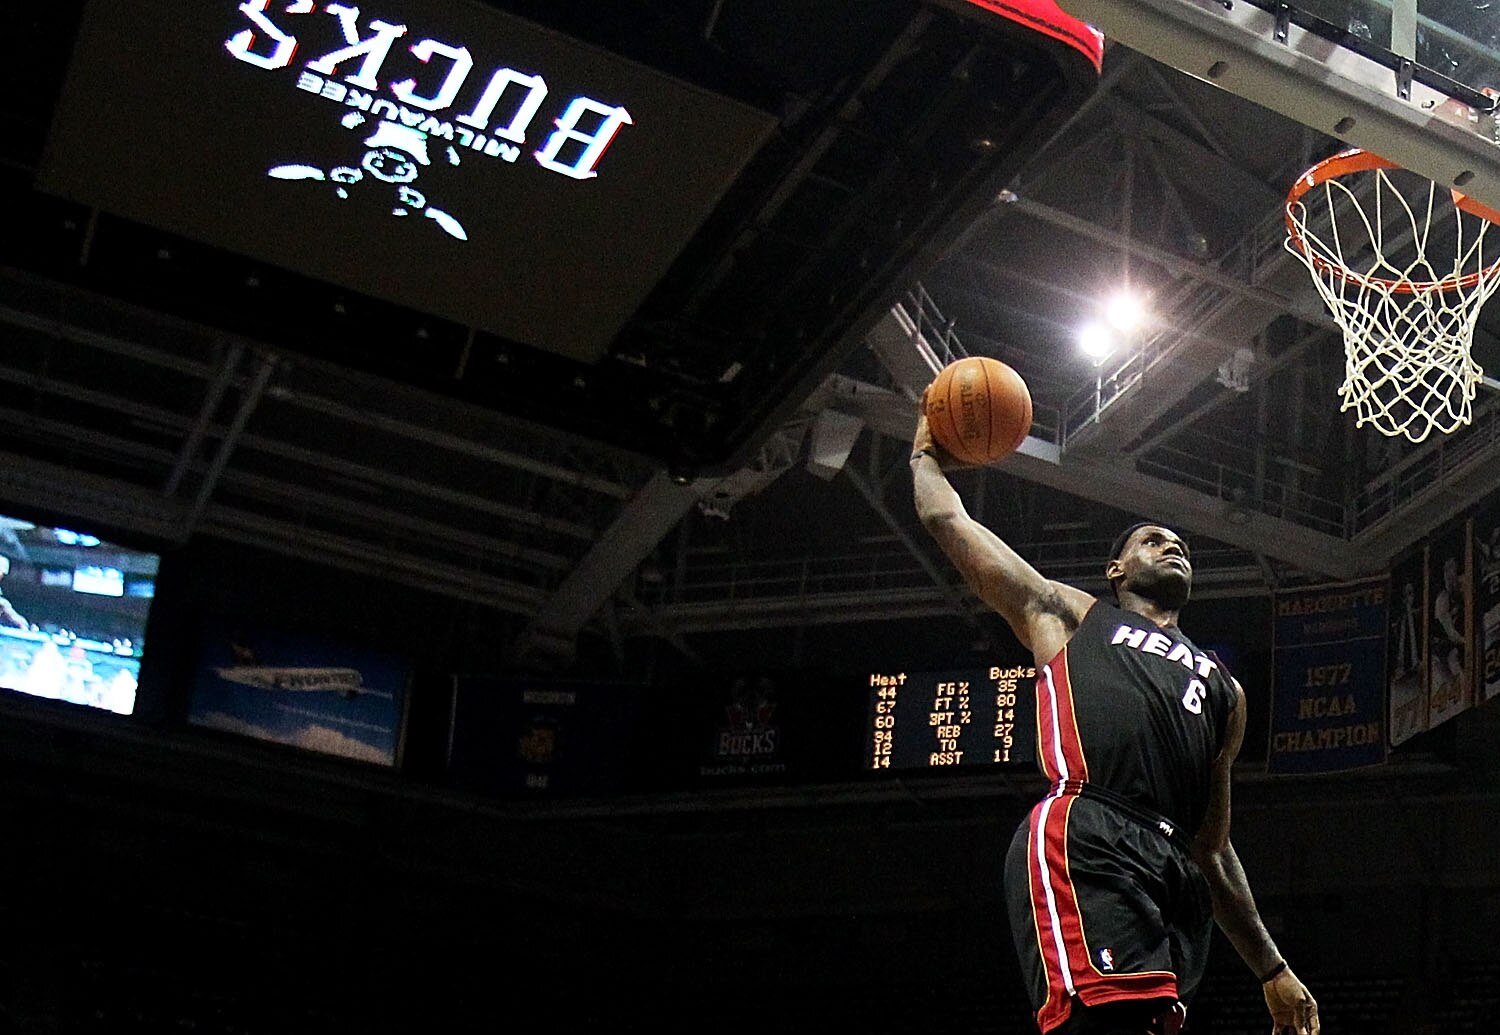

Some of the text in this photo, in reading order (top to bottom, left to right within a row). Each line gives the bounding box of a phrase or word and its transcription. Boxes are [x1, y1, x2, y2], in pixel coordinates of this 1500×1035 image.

[226, 0, 634, 180] BUCKS
[297, 71, 521, 163] MILWAUKEE
[1278, 588, 1385, 617] MARQUETTE
[1110, 624, 1218, 679] HEAT
[870, 665, 1036, 687] Heat Bucks
[1304, 663, 1353, 687] 1977
[878, 679, 1017, 700] 44 FG % 35
[1182, 679, 1207, 715] 6
[876, 693, 1016, 714] 67 FT % 80
[1298, 694, 1358, 720] NCAA
[875, 708, 1014, 729] 60 3PT % 14
[718, 729, 776, 755] BUCKS
[874, 723, 1014, 744] 34 REB 27
[874, 735, 1013, 755] 12 TO 9
[1273, 721, 1381, 753] CHAMPION
[873, 749, 1010, 769] 14 ASST 11
